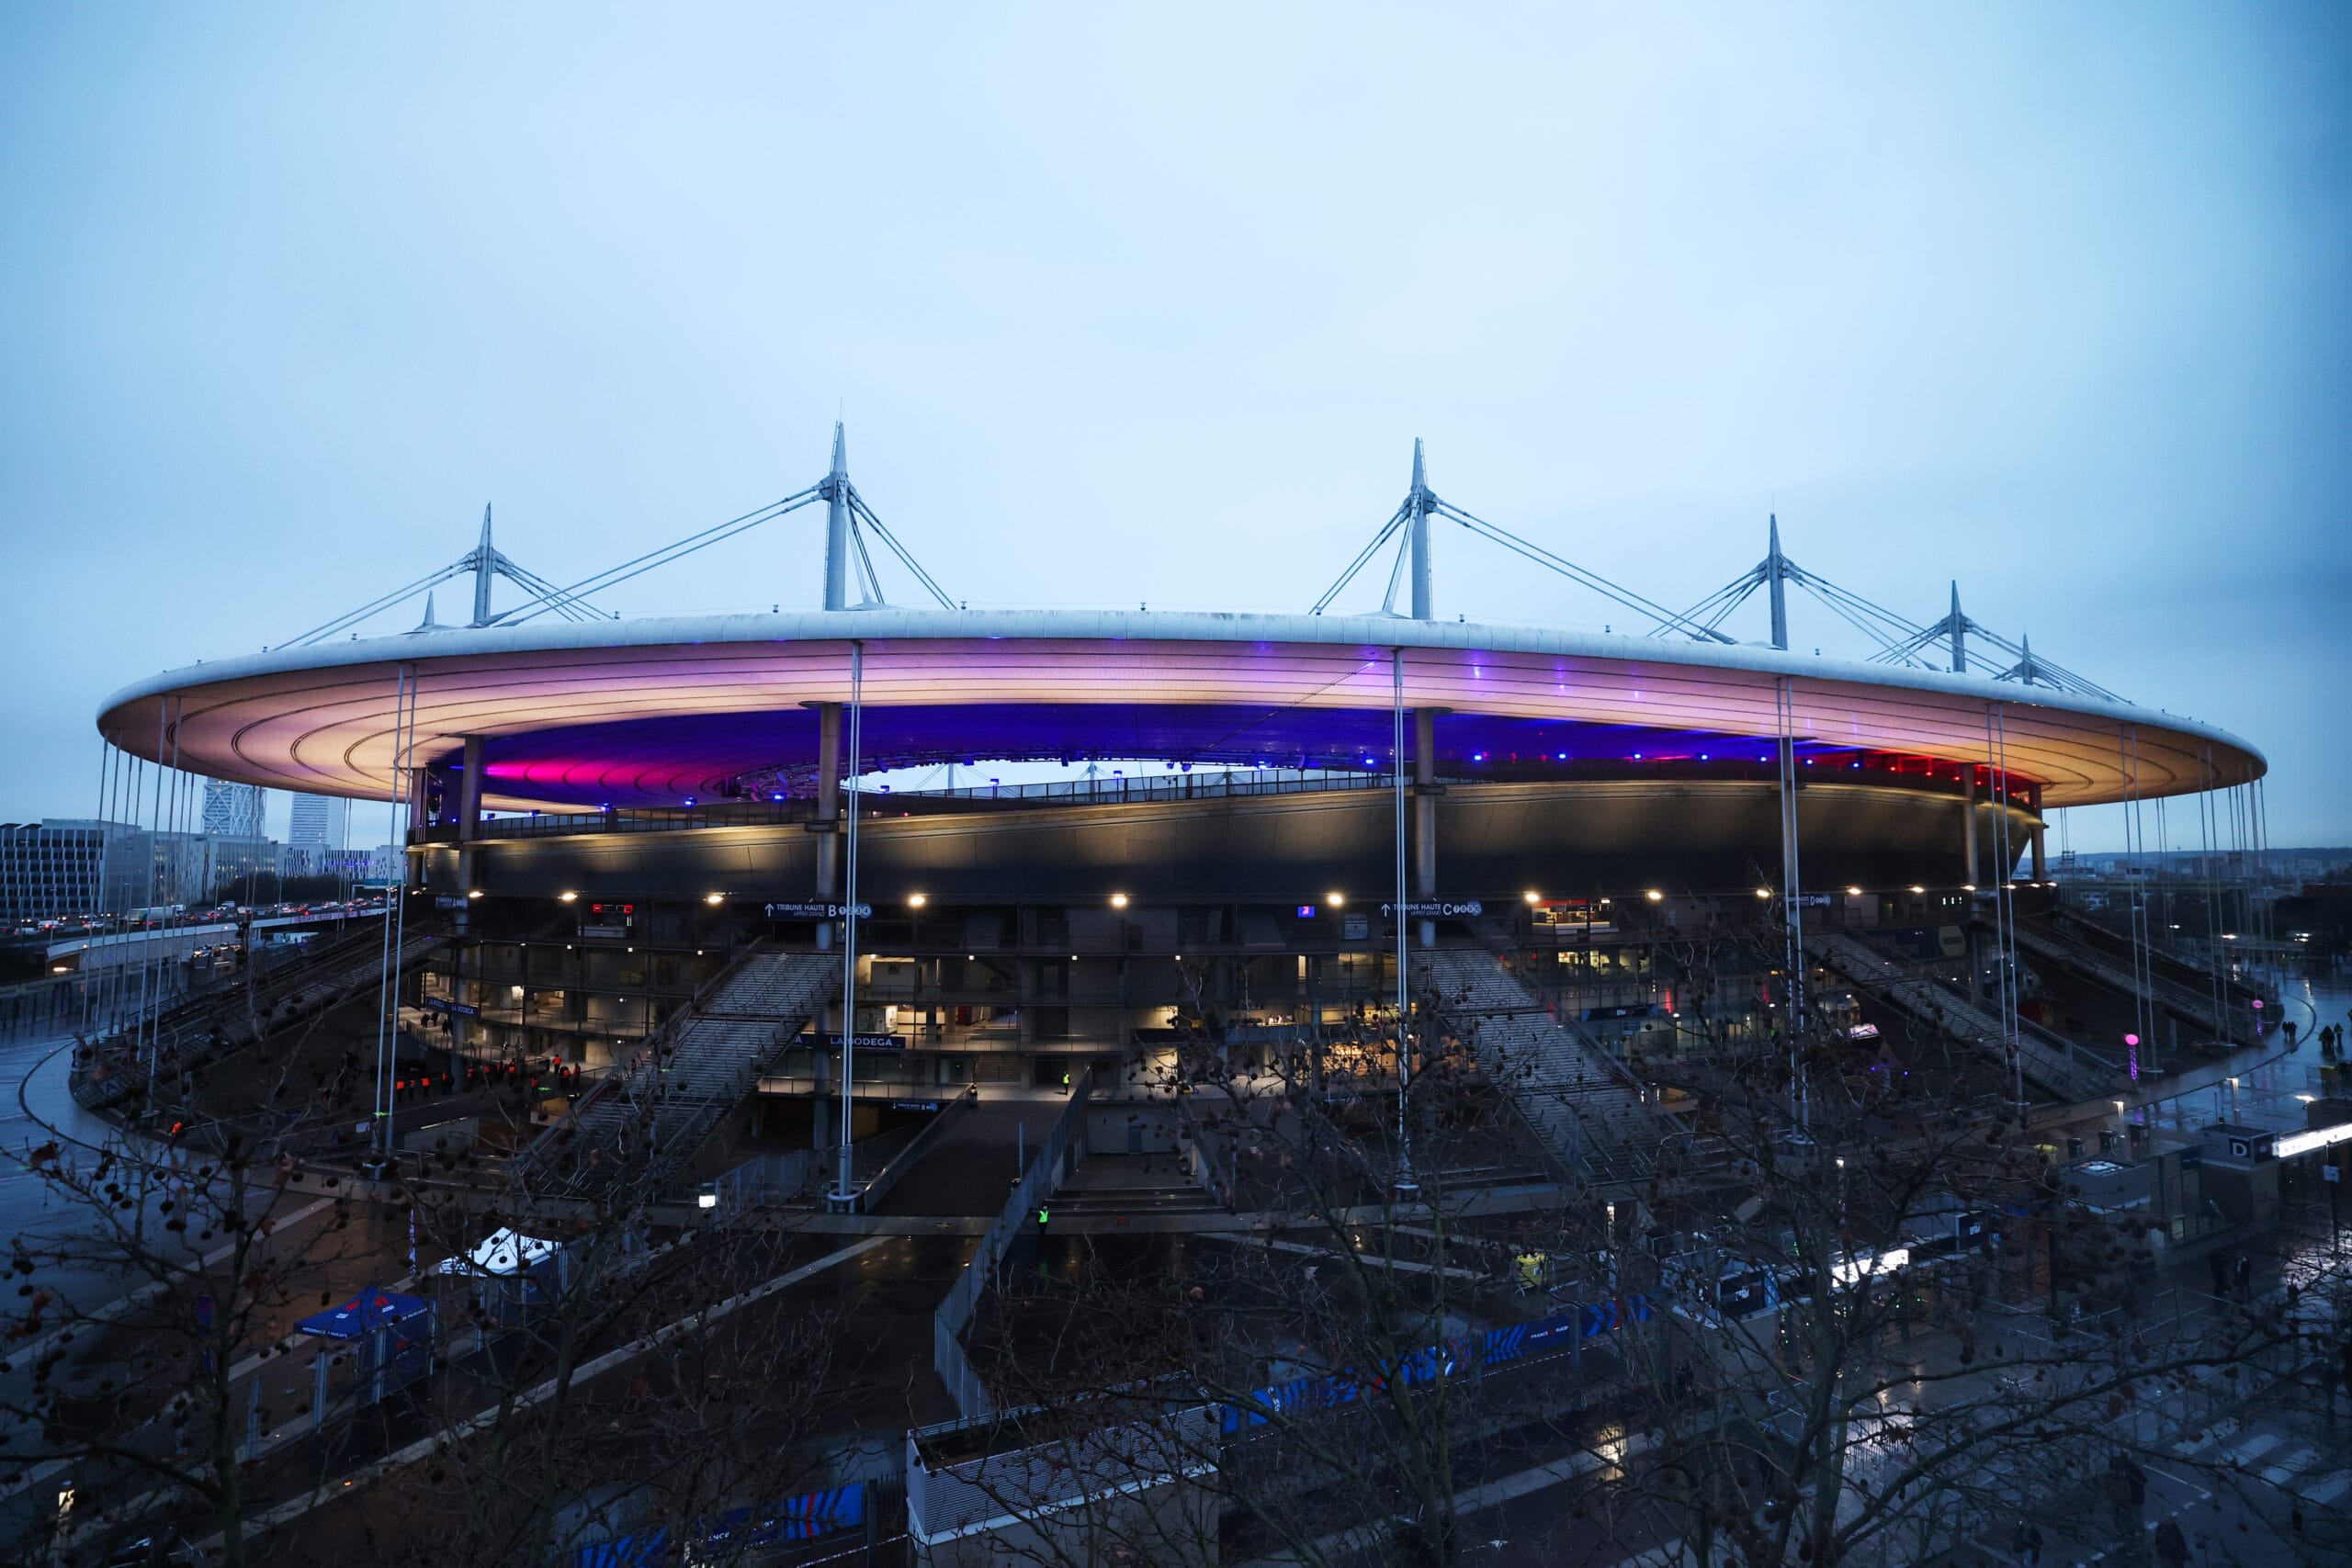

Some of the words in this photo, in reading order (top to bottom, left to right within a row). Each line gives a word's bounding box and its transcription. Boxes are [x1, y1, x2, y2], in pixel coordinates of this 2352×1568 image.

[828, 905, 837, 917] B
[1442, 903, 1452, 916] C
[830, 1036, 843, 1044] LA
[2233, 1142, 2248, 1156] D
